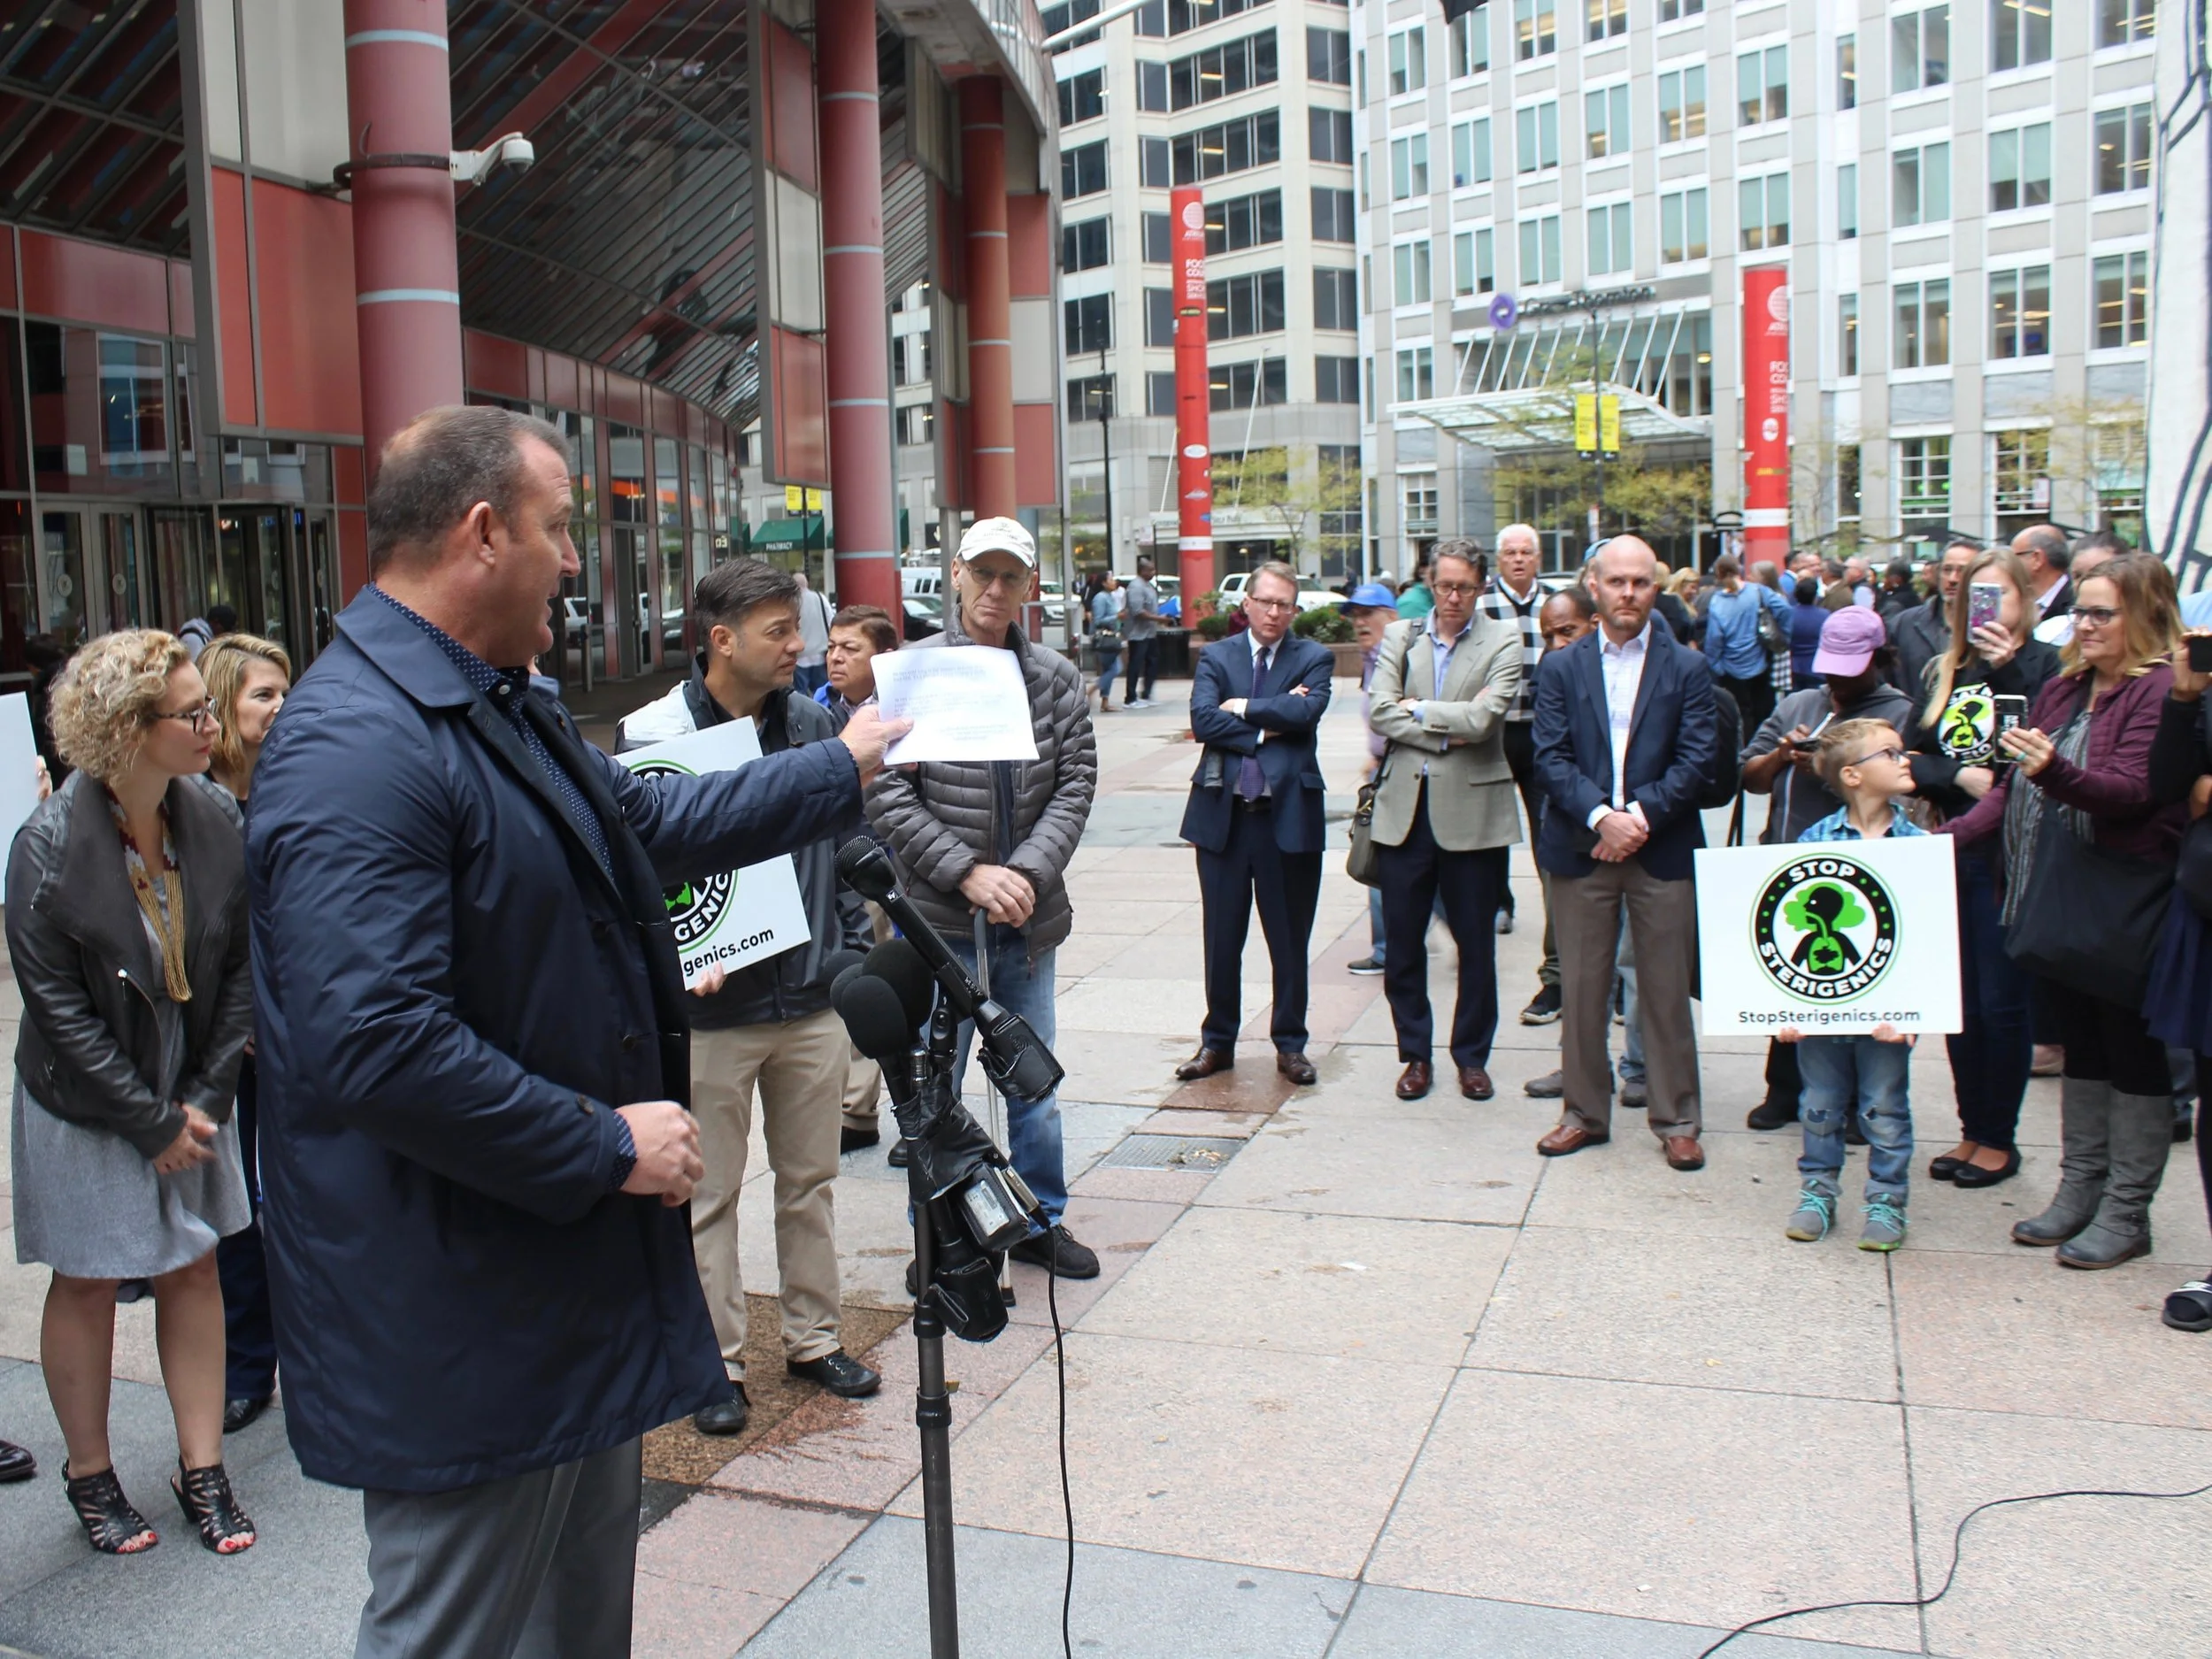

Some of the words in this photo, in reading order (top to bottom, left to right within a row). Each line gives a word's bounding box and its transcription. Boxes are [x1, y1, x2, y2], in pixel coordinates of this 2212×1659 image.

[1787, 859, 1856, 883] STOP
[674, 873, 728, 941] GENIC
[683, 926, 775, 977] genics.com
[1759, 937, 1893, 998] STERIGENICS
[1739, 1009, 1920, 1025] StopSterigenics.com
